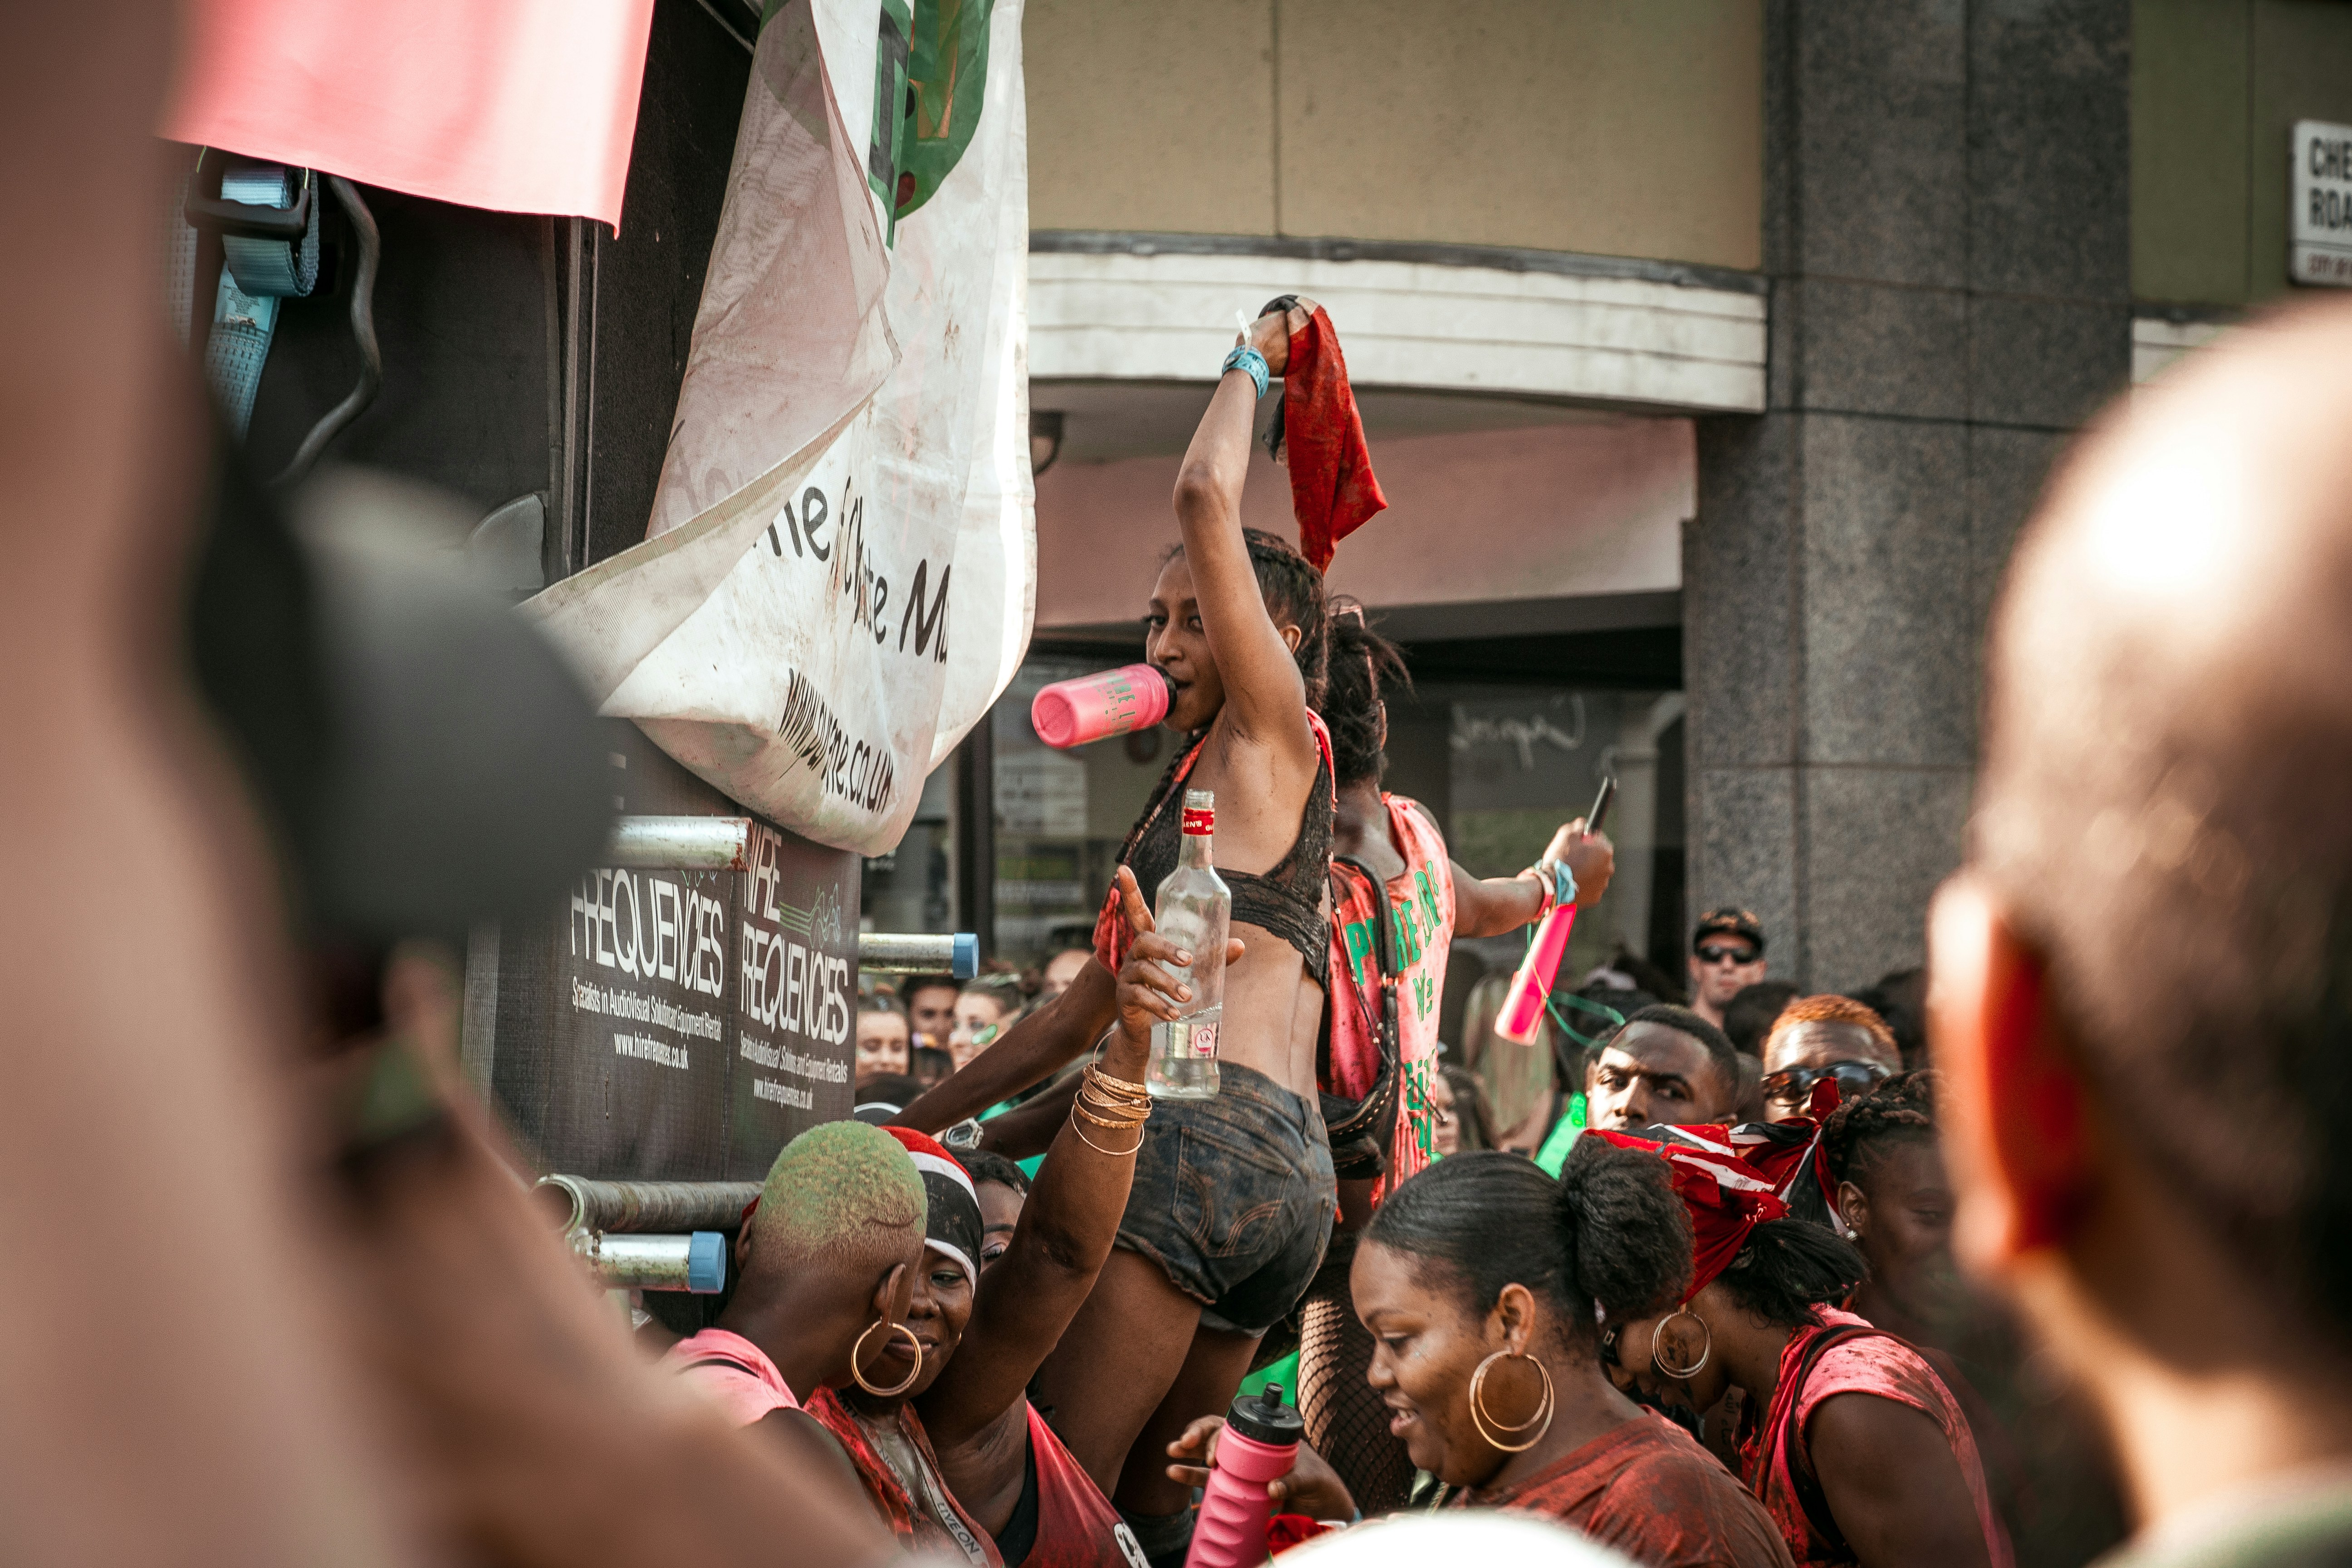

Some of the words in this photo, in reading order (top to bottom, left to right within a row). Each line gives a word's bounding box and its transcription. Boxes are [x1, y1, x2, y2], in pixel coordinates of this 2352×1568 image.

[571, 868, 724, 998] FREQUENCIES
[601, 985, 608, 1015] in
[609, 987, 650, 1023] AudioVisual
[676, 1004, 704, 1040] Equipment
[740, 921, 849, 1045] FREQUENCIES
[937, 1501, 959, 1531] LIVE
[957, 1531, 980, 1555] ON
